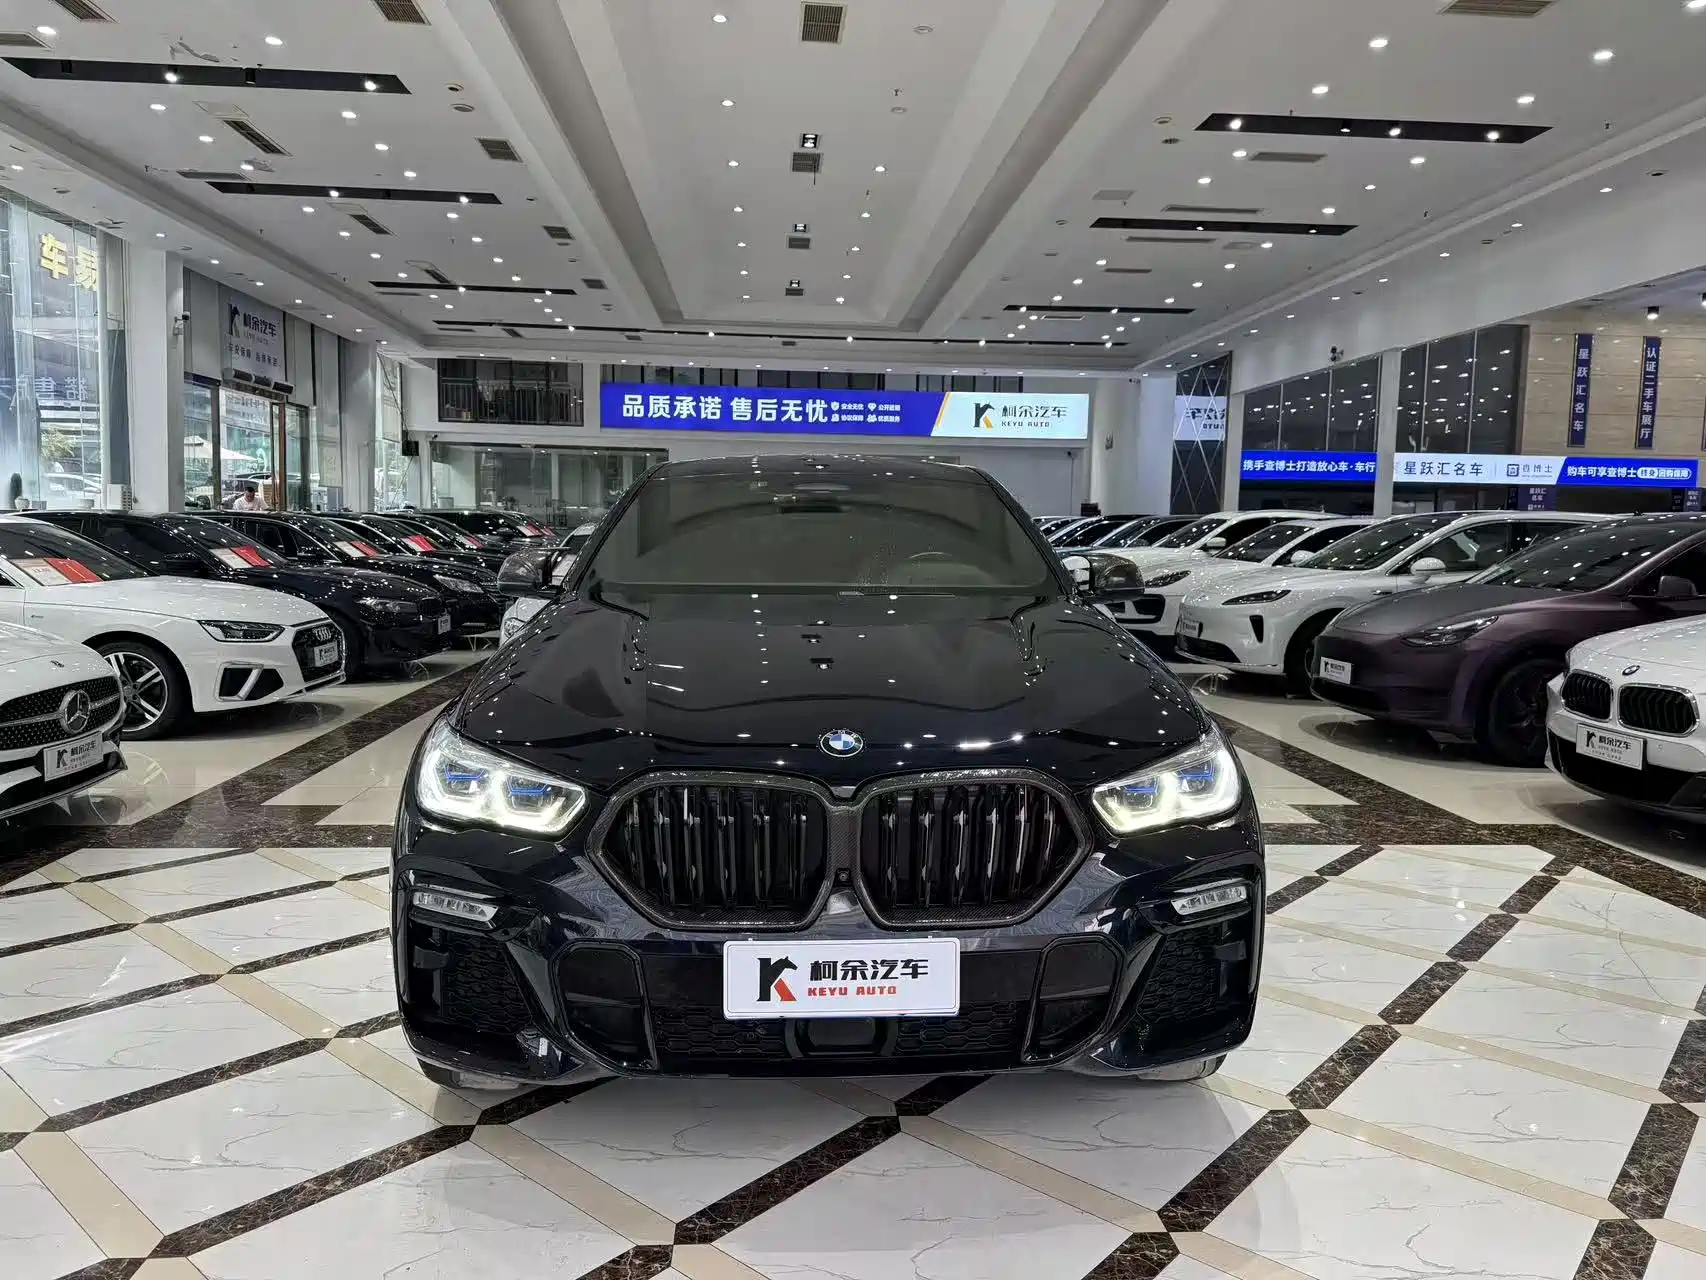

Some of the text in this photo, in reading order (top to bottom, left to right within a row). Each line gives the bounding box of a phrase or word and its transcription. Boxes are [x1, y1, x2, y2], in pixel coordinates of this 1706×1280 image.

[1573, 348, 1590, 432] 星跃汇名车
[1640, 347, 1657, 439] 认证二手车展厅
[622, 394, 828, 423] 品质承诺 售后无忧
[1001, 405, 1068, 418] 柯余汽车
[1403, 461, 1483, 476] 星跃汇名车
[810, 958, 929, 981] 柯余汽车
[807, 986, 897, 997] KEYU AUTO
